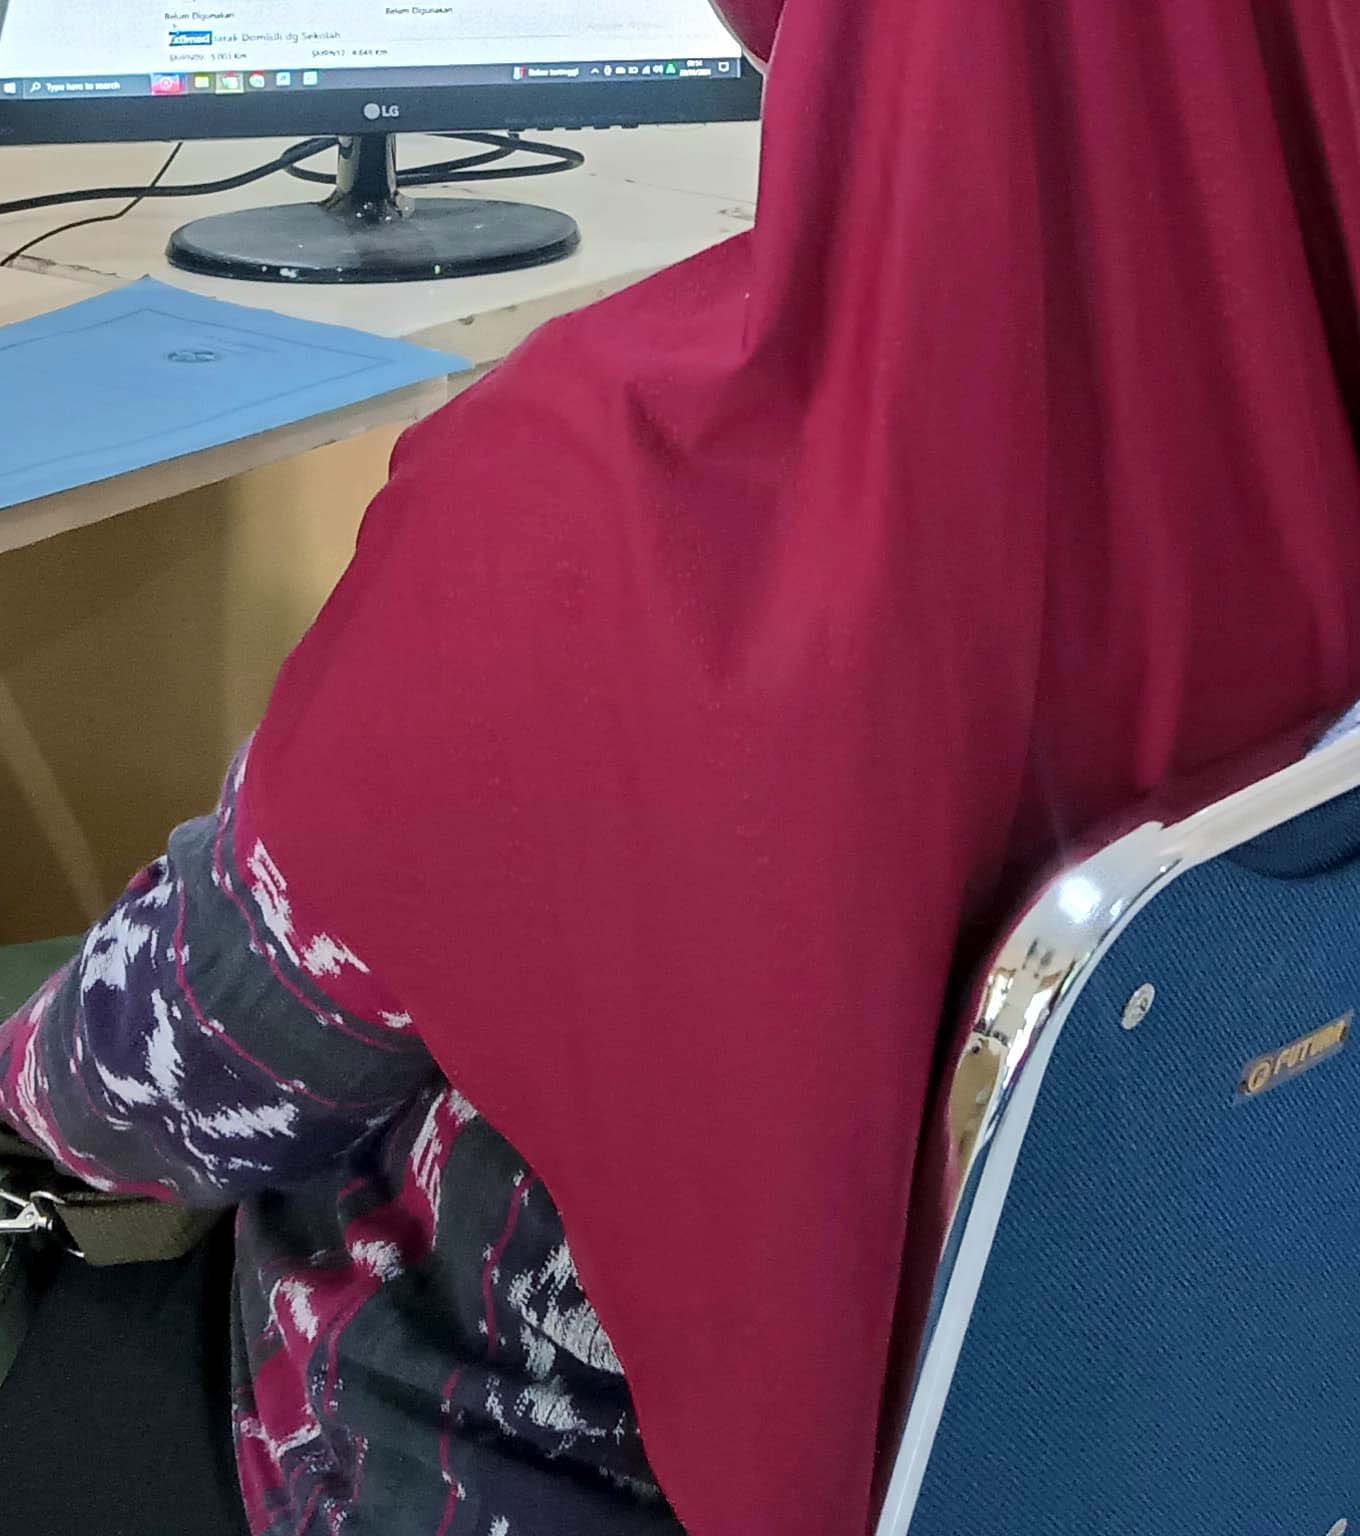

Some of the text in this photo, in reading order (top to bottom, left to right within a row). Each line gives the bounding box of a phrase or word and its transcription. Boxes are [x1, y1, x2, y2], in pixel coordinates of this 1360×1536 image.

[241, 31, 283, 42] Domisili
[285, 32, 299, 44] dg
[301, 30, 341, 41] Sekolah
[46, 82, 65, 92] Type
[66, 82, 83, 91] here
[95, 81, 121, 91] search
[381, 105, 400, 118] LG
